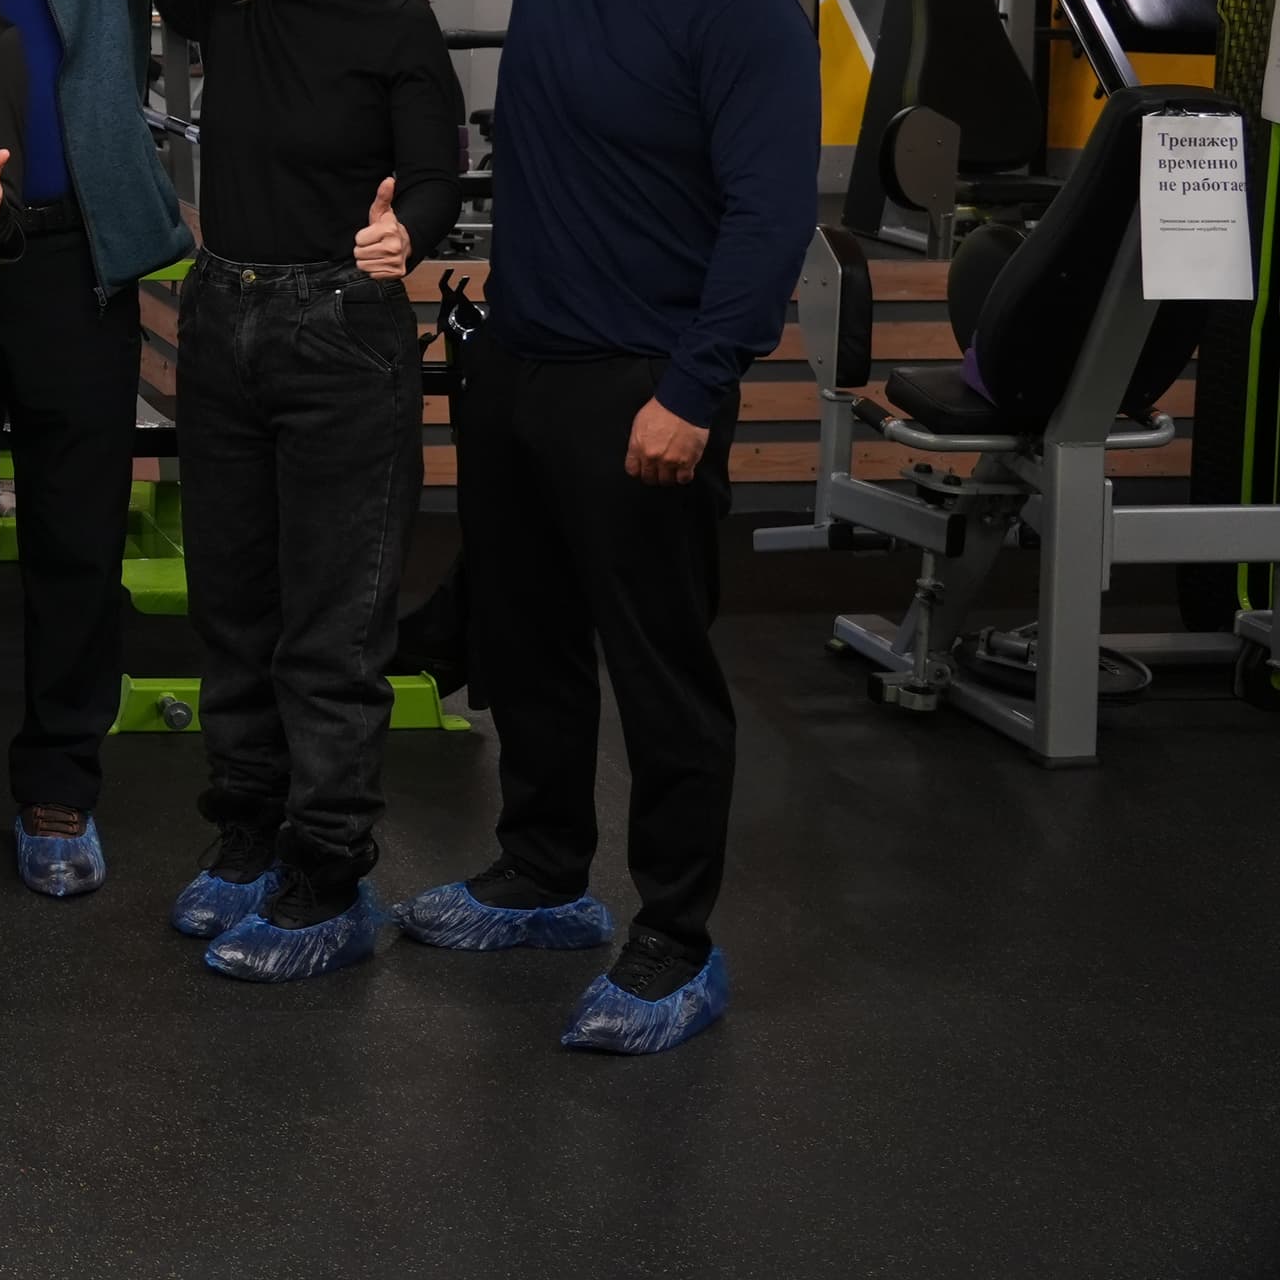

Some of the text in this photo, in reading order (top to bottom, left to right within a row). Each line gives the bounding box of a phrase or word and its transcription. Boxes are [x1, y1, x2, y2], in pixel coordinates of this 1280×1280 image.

[1157, 132, 1238, 149] Тренажер
[1159, 158, 1238, 172] временно
[1159, 180, 1177, 191] не
